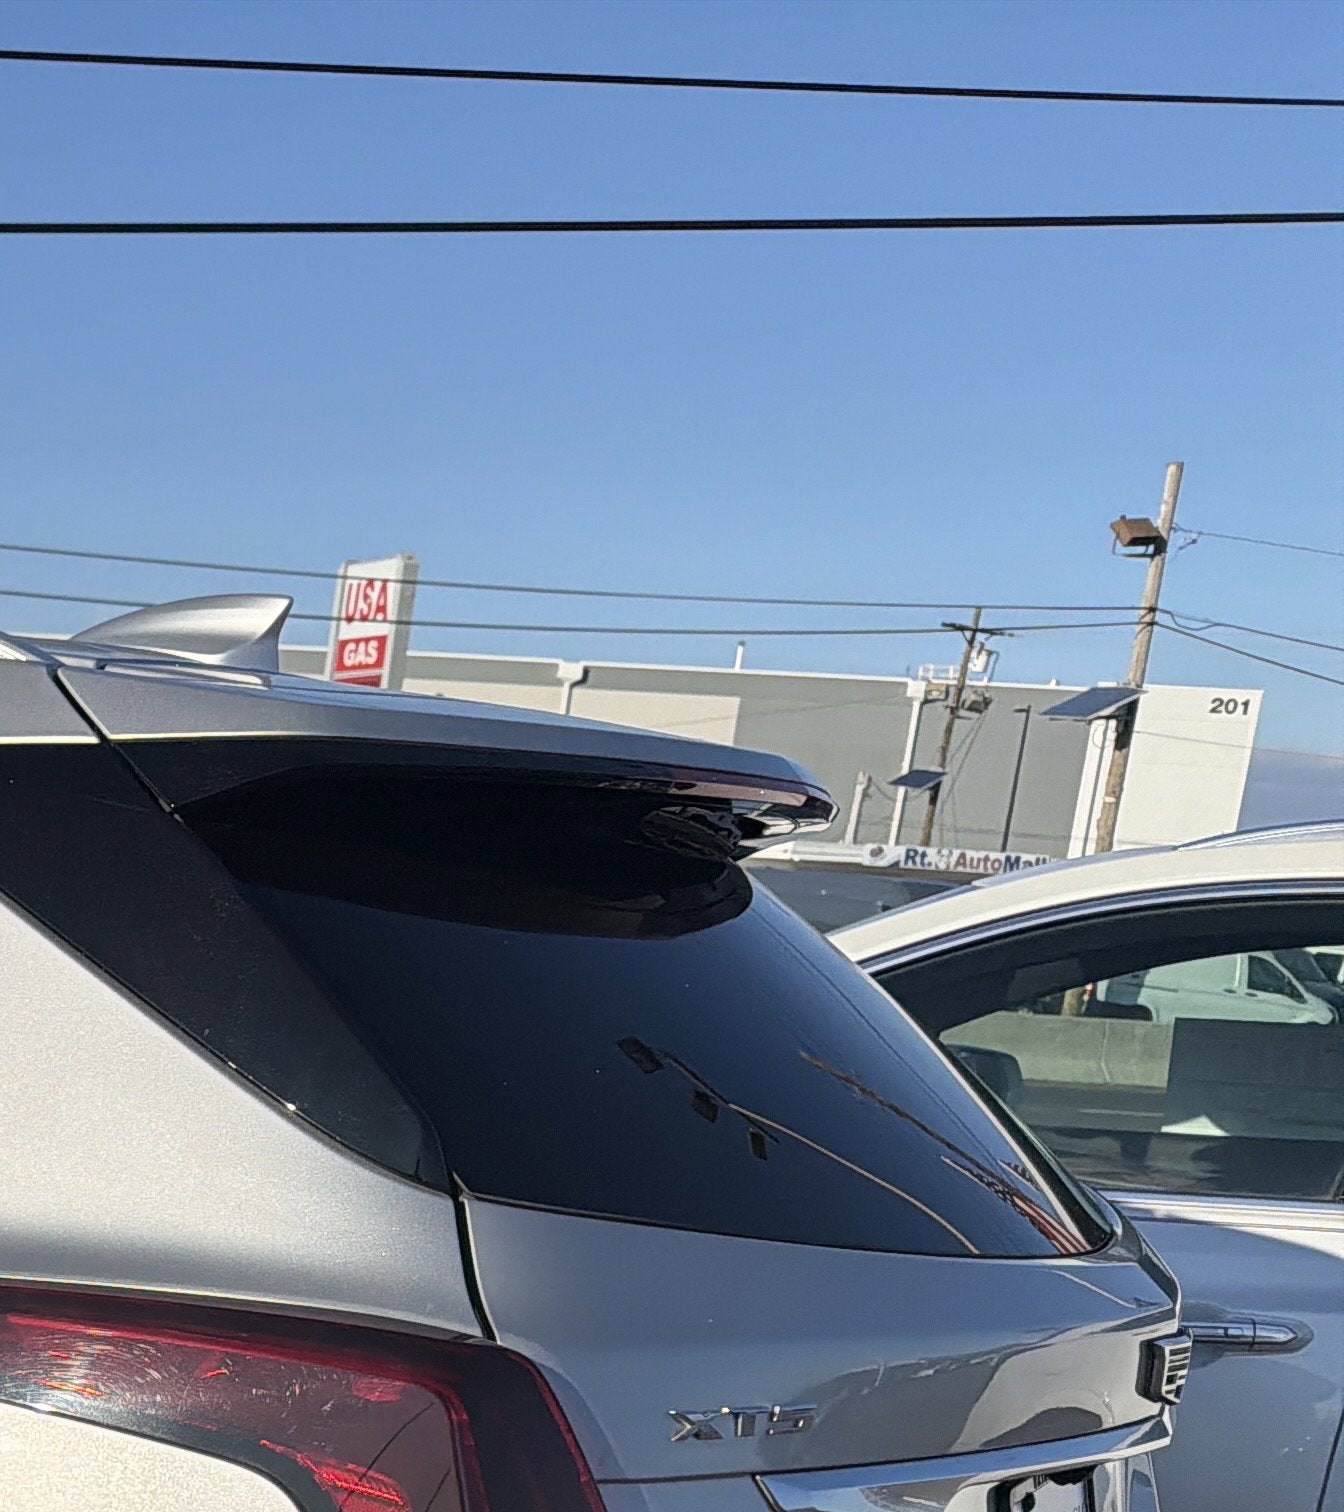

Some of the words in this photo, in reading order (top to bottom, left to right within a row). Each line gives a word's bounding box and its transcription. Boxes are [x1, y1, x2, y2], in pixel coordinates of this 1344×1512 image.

[345, 579, 389, 623] USA
[342, 640, 379, 667] GAS
[1208, 697, 1251, 716] 201
[903, 848, 933, 868] Rt.
[667, 1404, 818, 1442] XT5
